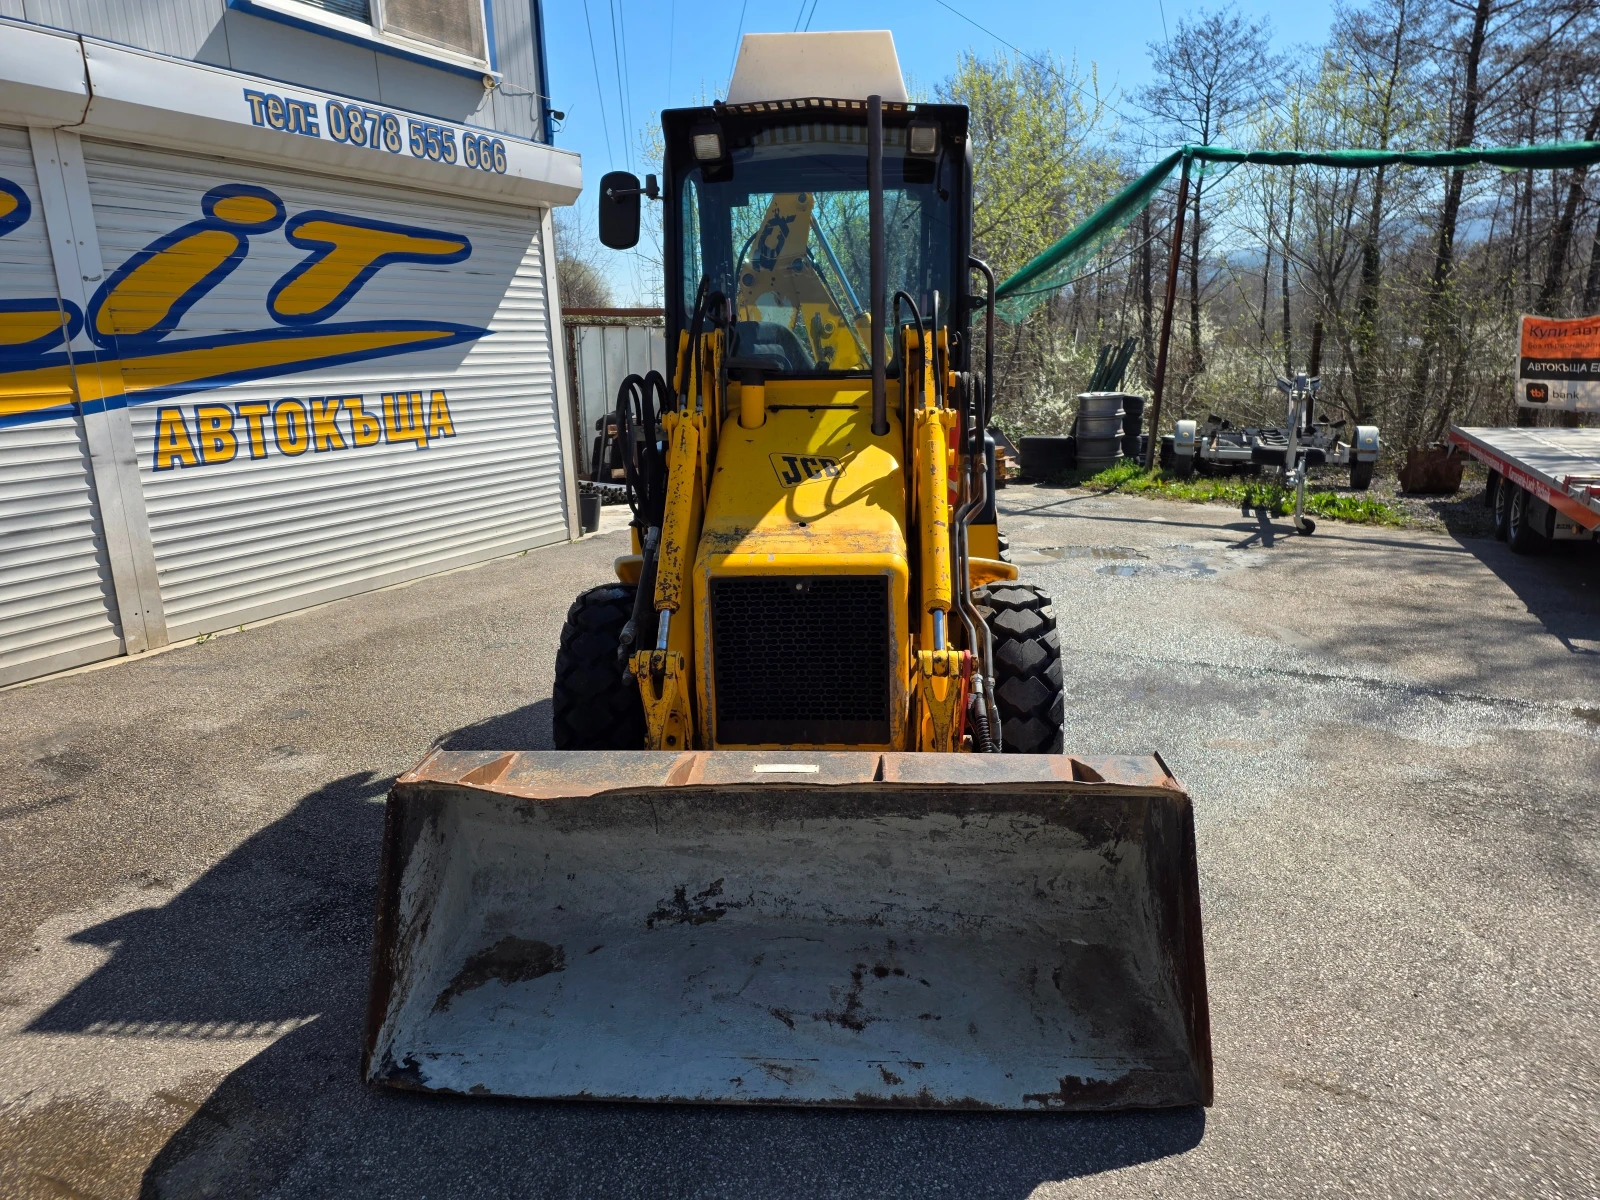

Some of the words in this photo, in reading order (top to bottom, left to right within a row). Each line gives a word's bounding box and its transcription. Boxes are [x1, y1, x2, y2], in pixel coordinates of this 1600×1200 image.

[243, 88, 320, 137] тел:
[325, 100, 402, 153] 0878
[407, 118, 458, 164] 555
[462, 131, 507, 174] 666
[1529, 325, 1568, 340] Купи
[1527, 361, 1588, 375] АВТОКЪЩА
[1530, 388, 1545, 398] tbi
[1552, 390, 1580, 400] bank
[152, 389, 457, 472] АВТОКЪЩА
[781, 455, 841, 485] JCB
